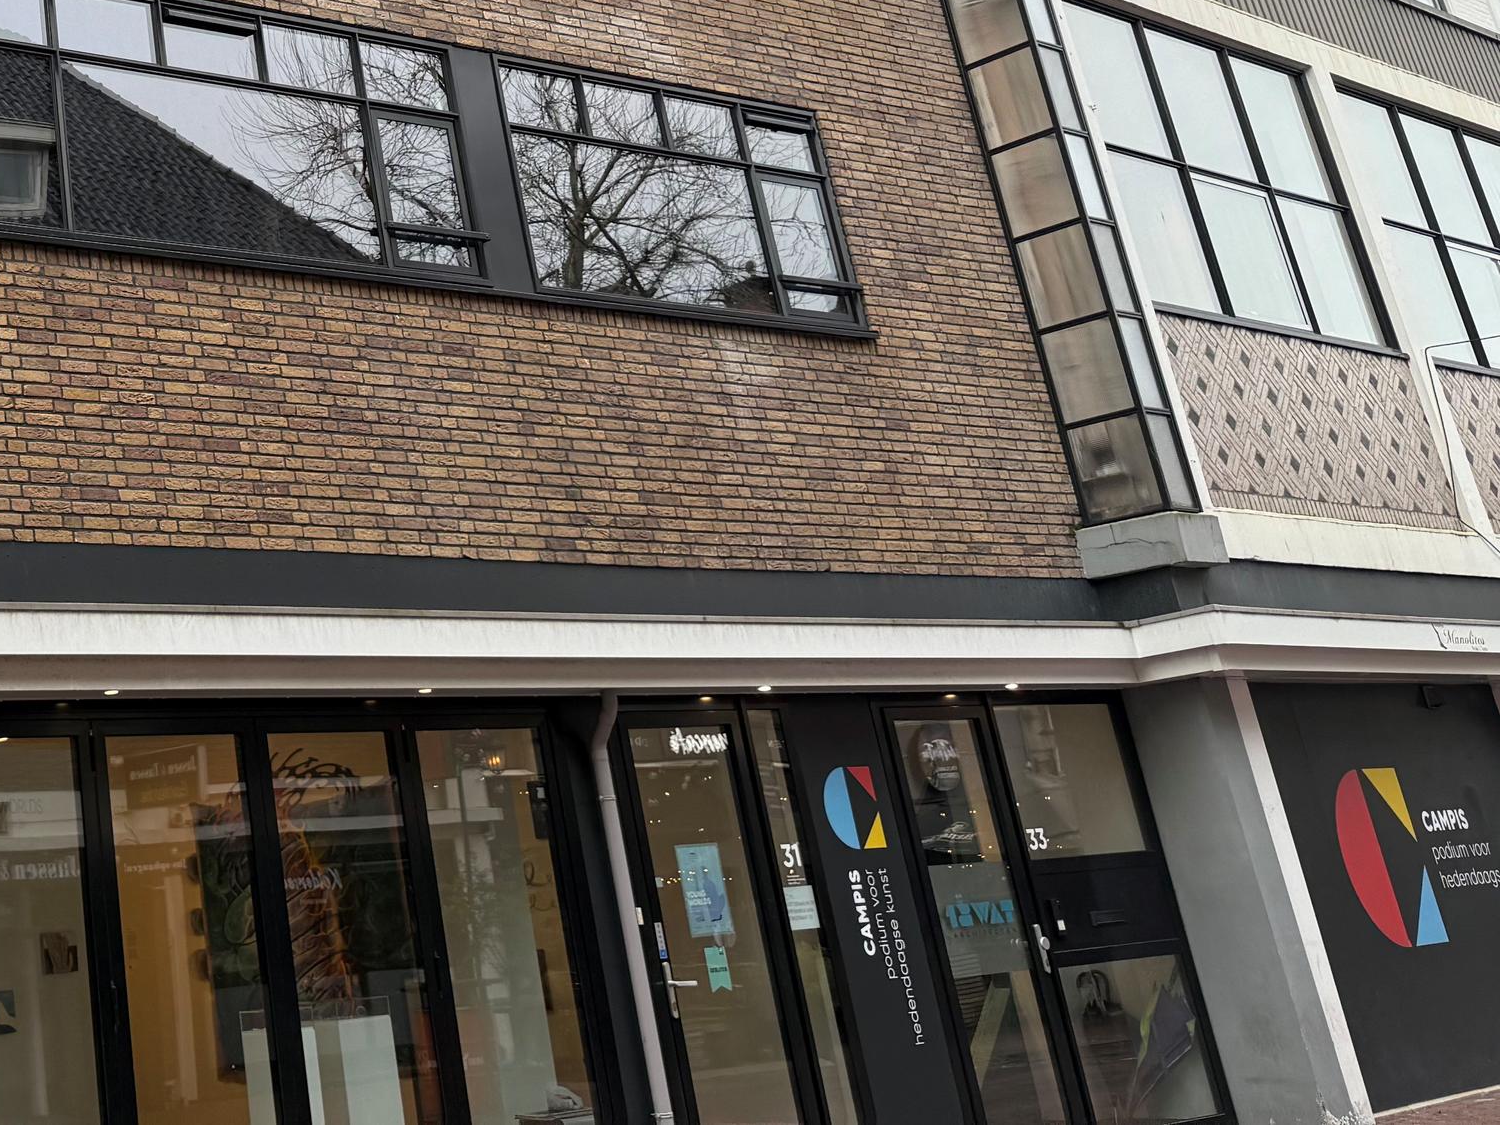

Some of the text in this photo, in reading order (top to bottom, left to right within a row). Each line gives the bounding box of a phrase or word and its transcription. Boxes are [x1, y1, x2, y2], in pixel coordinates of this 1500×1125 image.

[1421, 808, 1469, 832] CAMPIS
[1025, 828, 1048, 850] 33
[780, 842, 802, 867] 31
[1431, 841, 1491, 865] podium voor
[849, 869, 876, 956] CAMPIS
[865, 868, 899, 980] podium voor
[878, 868, 925, 1046] hedendaagse kunst
